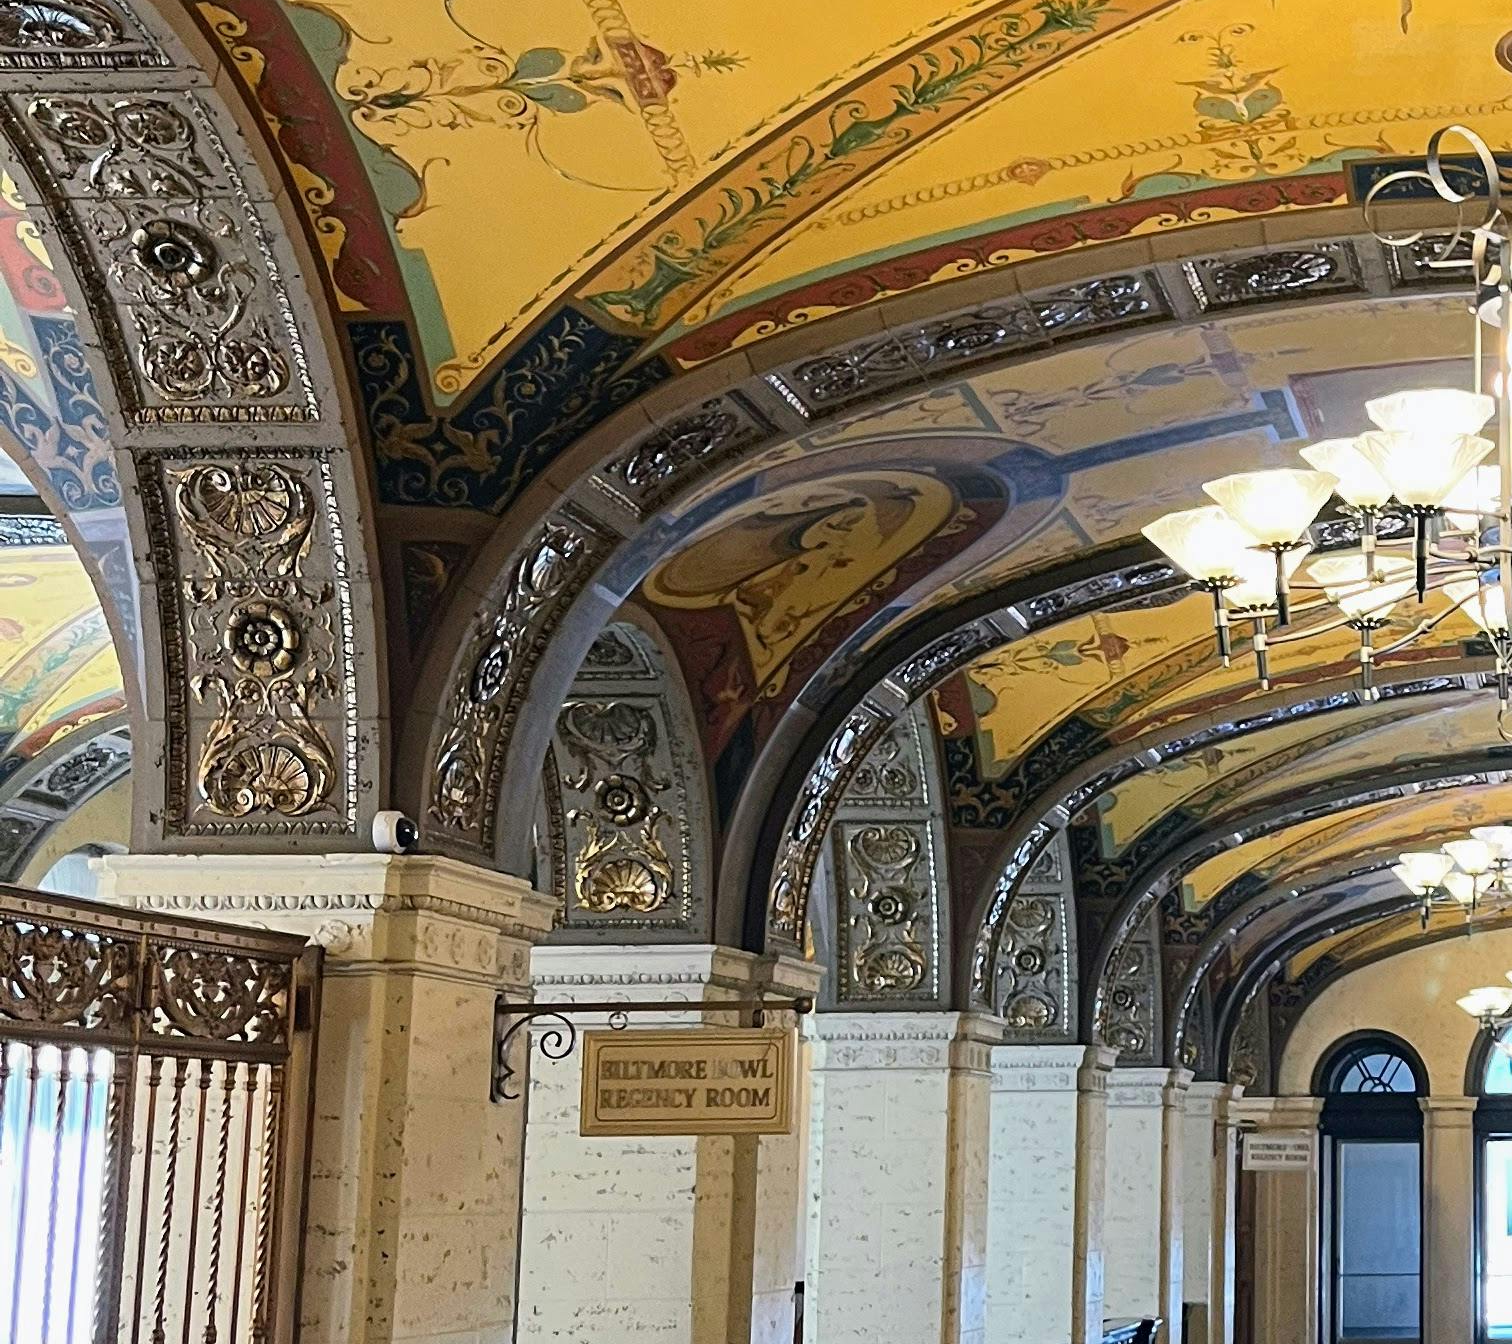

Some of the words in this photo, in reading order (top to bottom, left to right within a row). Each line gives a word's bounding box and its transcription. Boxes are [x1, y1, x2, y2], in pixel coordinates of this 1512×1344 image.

[601, 1060, 707, 1080] BILTMORE
[711, 1059, 773, 1079] BOWL
[599, 1088, 697, 1109] REGENCY
[705, 1087, 771, 1108] ROOM
